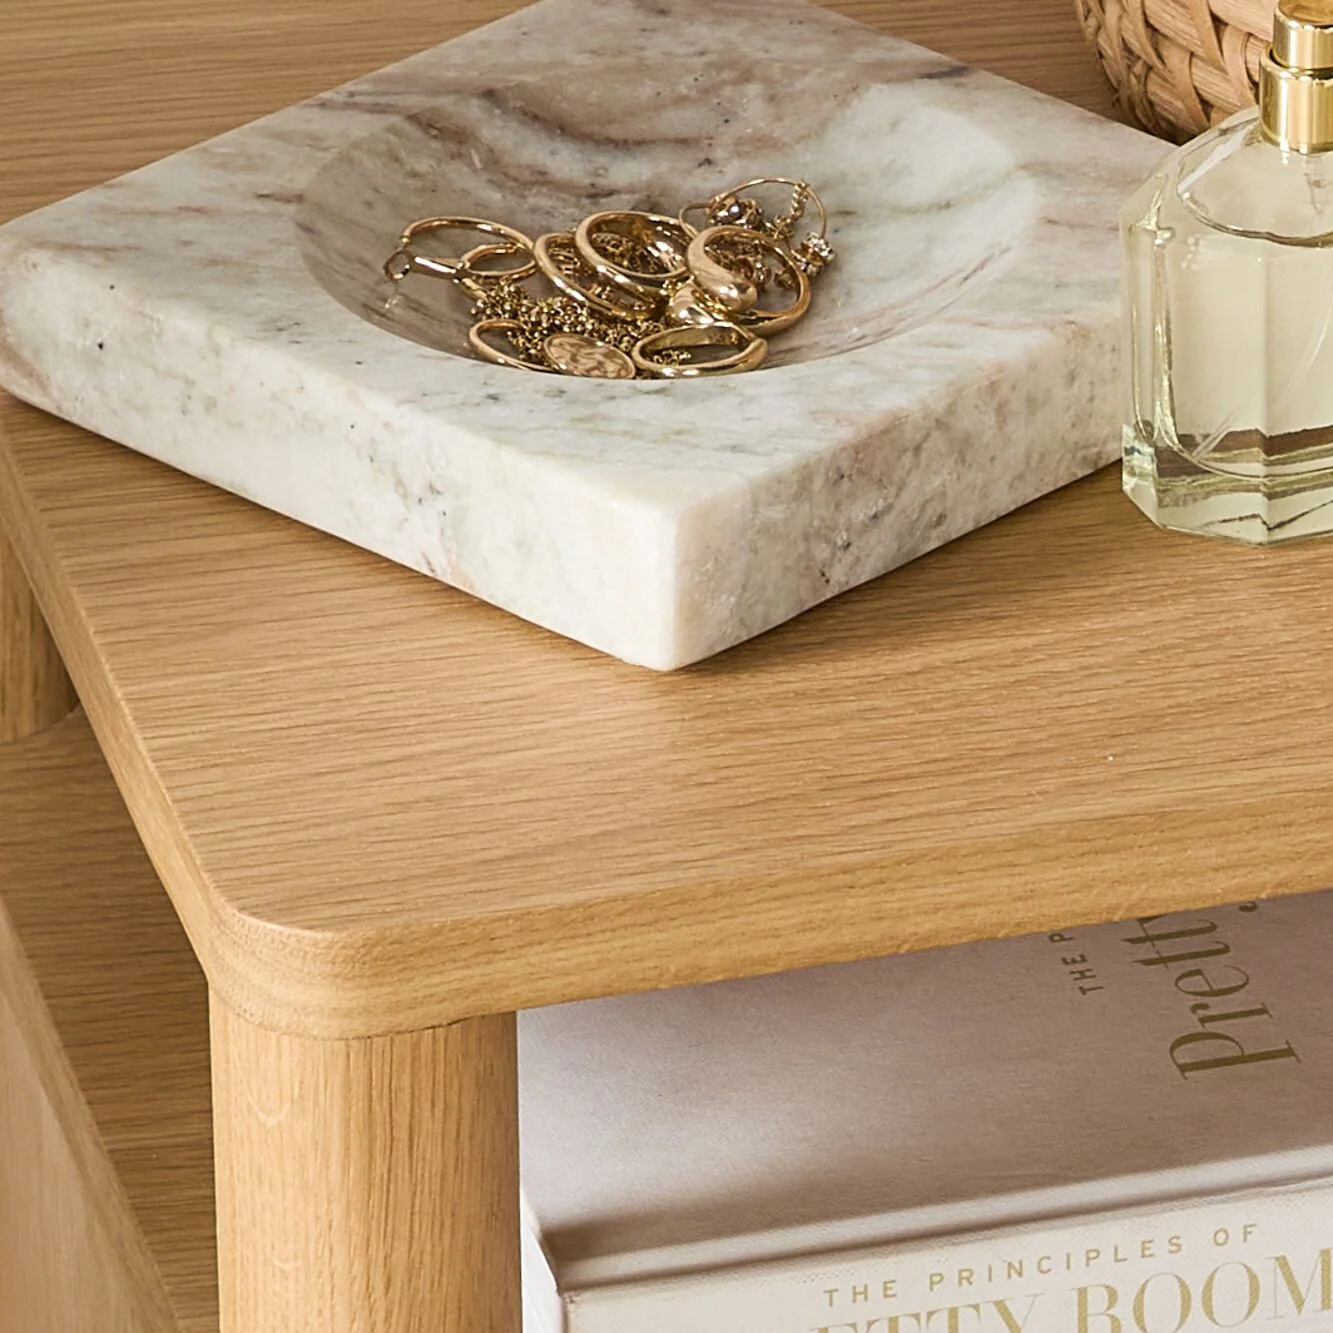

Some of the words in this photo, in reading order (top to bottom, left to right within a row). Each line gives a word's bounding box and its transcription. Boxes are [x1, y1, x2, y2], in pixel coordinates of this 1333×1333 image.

[1062, 953, 1104, 996] THE
[1121, 900, 1301, 1080] Prett
[823, 1280, 898, 1308] THE
[928, 1235, 1184, 1292] PRINCIPLES
[1212, 1224, 1259, 1247] OF
